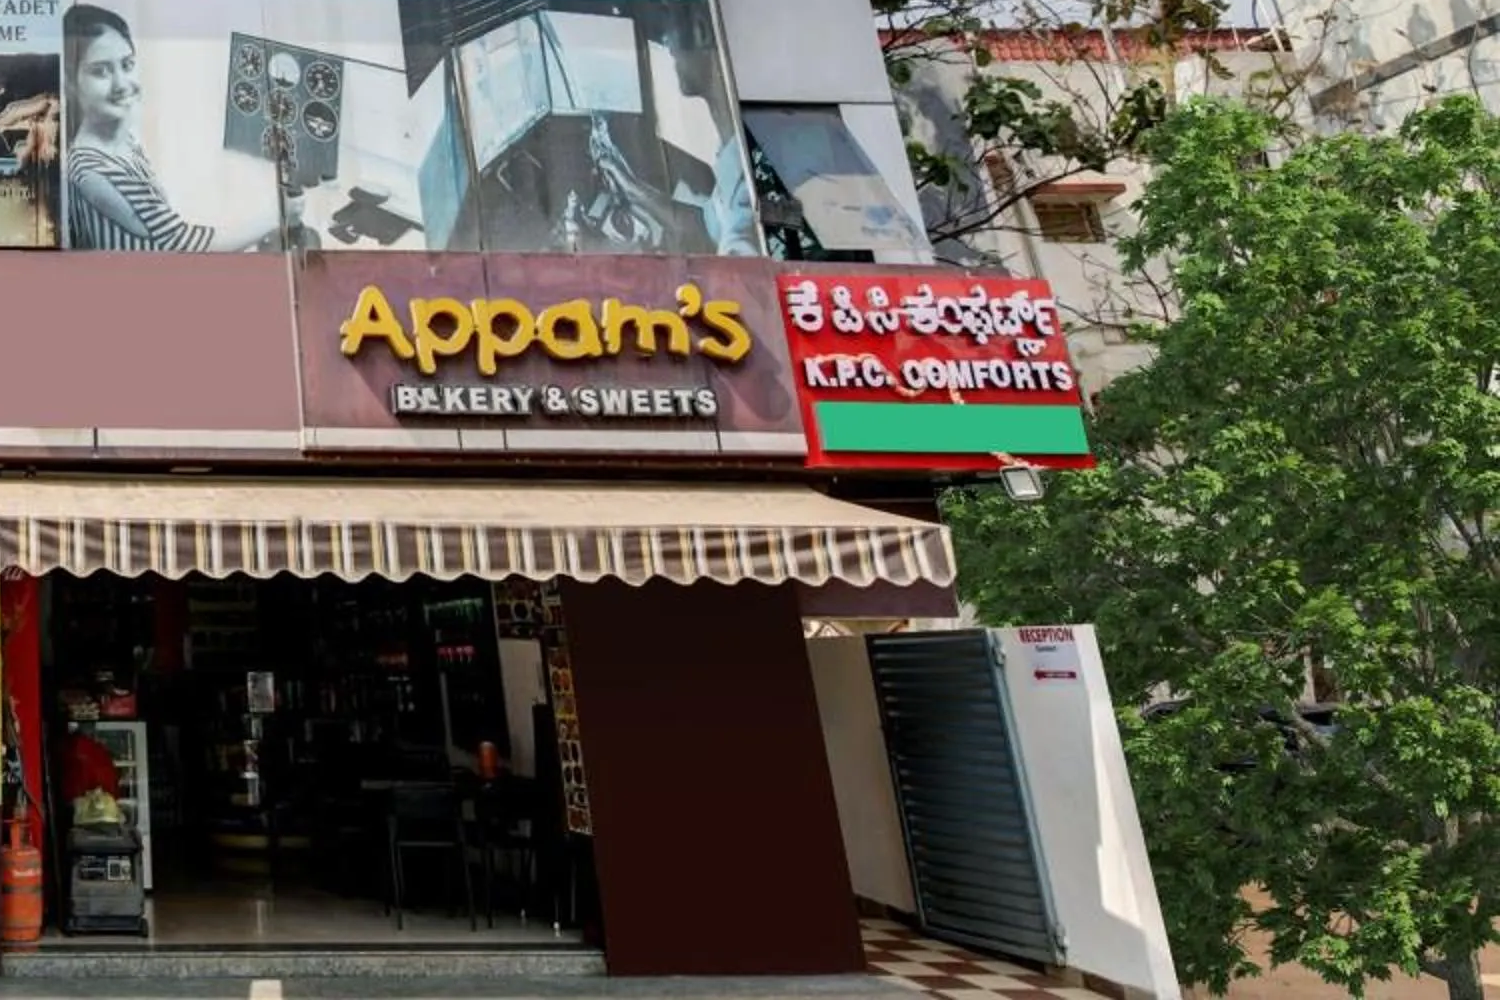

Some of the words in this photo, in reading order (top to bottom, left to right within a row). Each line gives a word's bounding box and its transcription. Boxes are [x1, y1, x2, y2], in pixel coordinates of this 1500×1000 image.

[340, 282, 752, 377] Appam's
[804, 357, 896, 388] K.P.C.
[902, 358, 1073, 391] COMFORTS
[395, 384, 533, 414] BAKERY
[543, 385, 570, 413] &
[577, 388, 718, 416] SWEETS
[1018, 627, 1076, 643] RECEPTION
